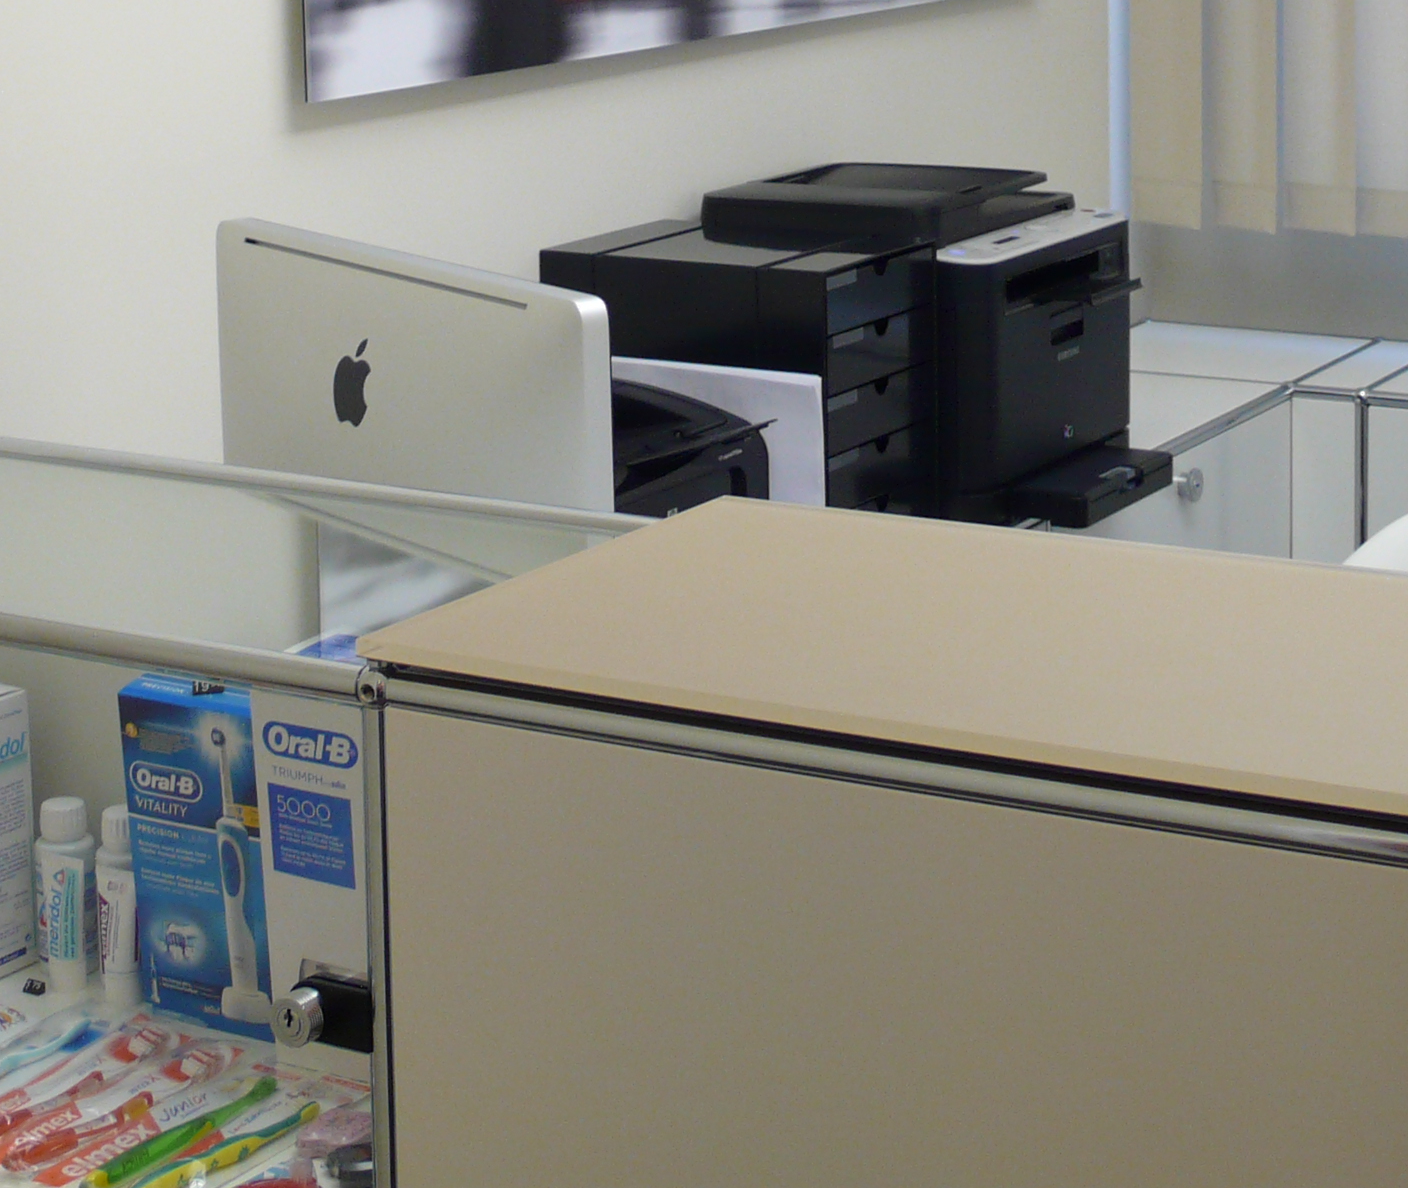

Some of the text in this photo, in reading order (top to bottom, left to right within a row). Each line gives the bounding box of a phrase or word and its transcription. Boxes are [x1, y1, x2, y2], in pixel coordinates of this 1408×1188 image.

[267, 725, 351, 765] Oral-B
[136, 767, 196, 796] Oral-B
[271, 764, 324, 786] TRIUMPH
[135, 795, 188, 818] VITALITY
[276, 794, 331, 823] 5000
[49, 885, 63, 959] meridol
[159, 1092, 208, 1123] Junior
[61, 1122, 156, 1178] elmex
